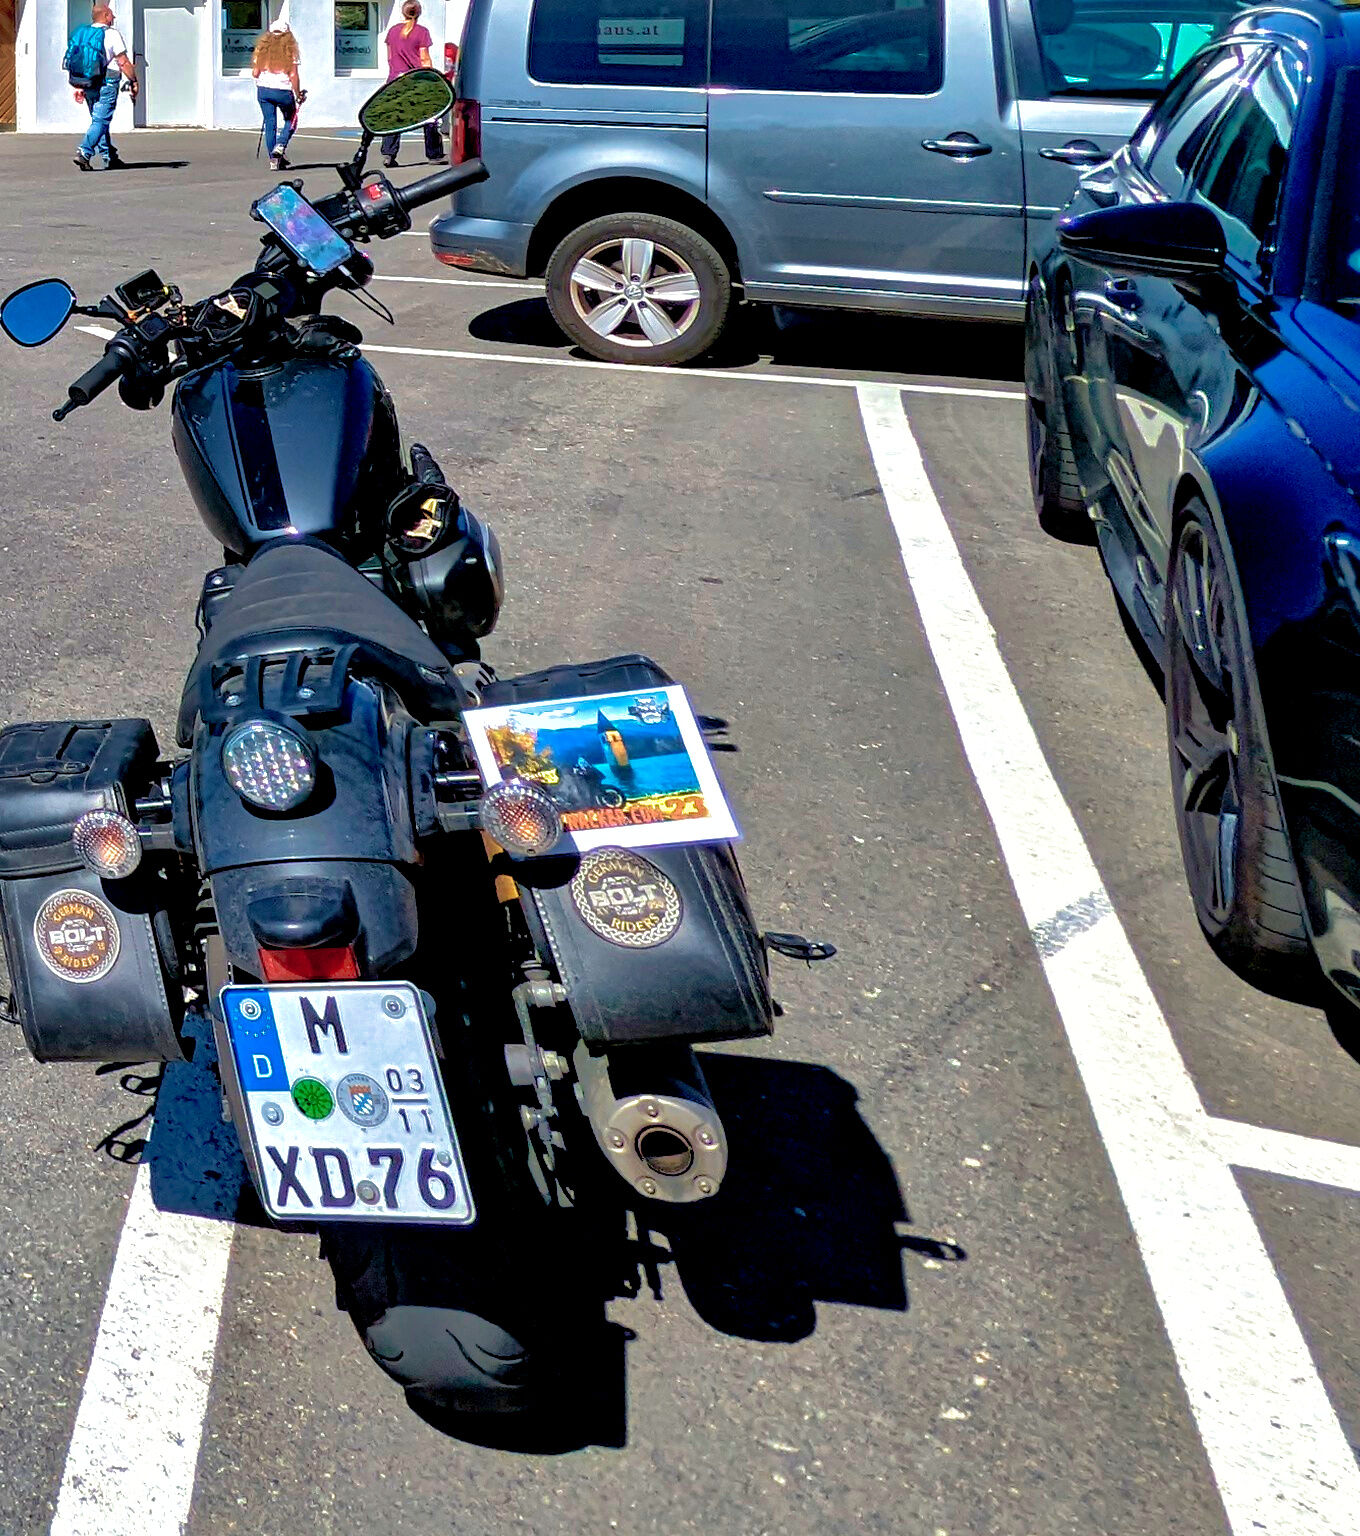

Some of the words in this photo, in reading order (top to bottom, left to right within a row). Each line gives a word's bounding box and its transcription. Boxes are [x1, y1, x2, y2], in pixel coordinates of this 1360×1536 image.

[587, 859, 645, 884] GERMAN
[588, 884, 657, 907] BOLT
[52, 903, 95, 922] GERMAN
[611, 913, 660, 932] RIDERS
[49, 926, 106, 945] BOLT
[60, 953, 100, 968] RIDERS
[299, 995, 349, 1055] M
[252, 1054, 273, 1078] D
[385, 1067, 425, 1093] 03
[397, 1108, 433, 1134] 11
[366, 1147, 457, 1210] 76
